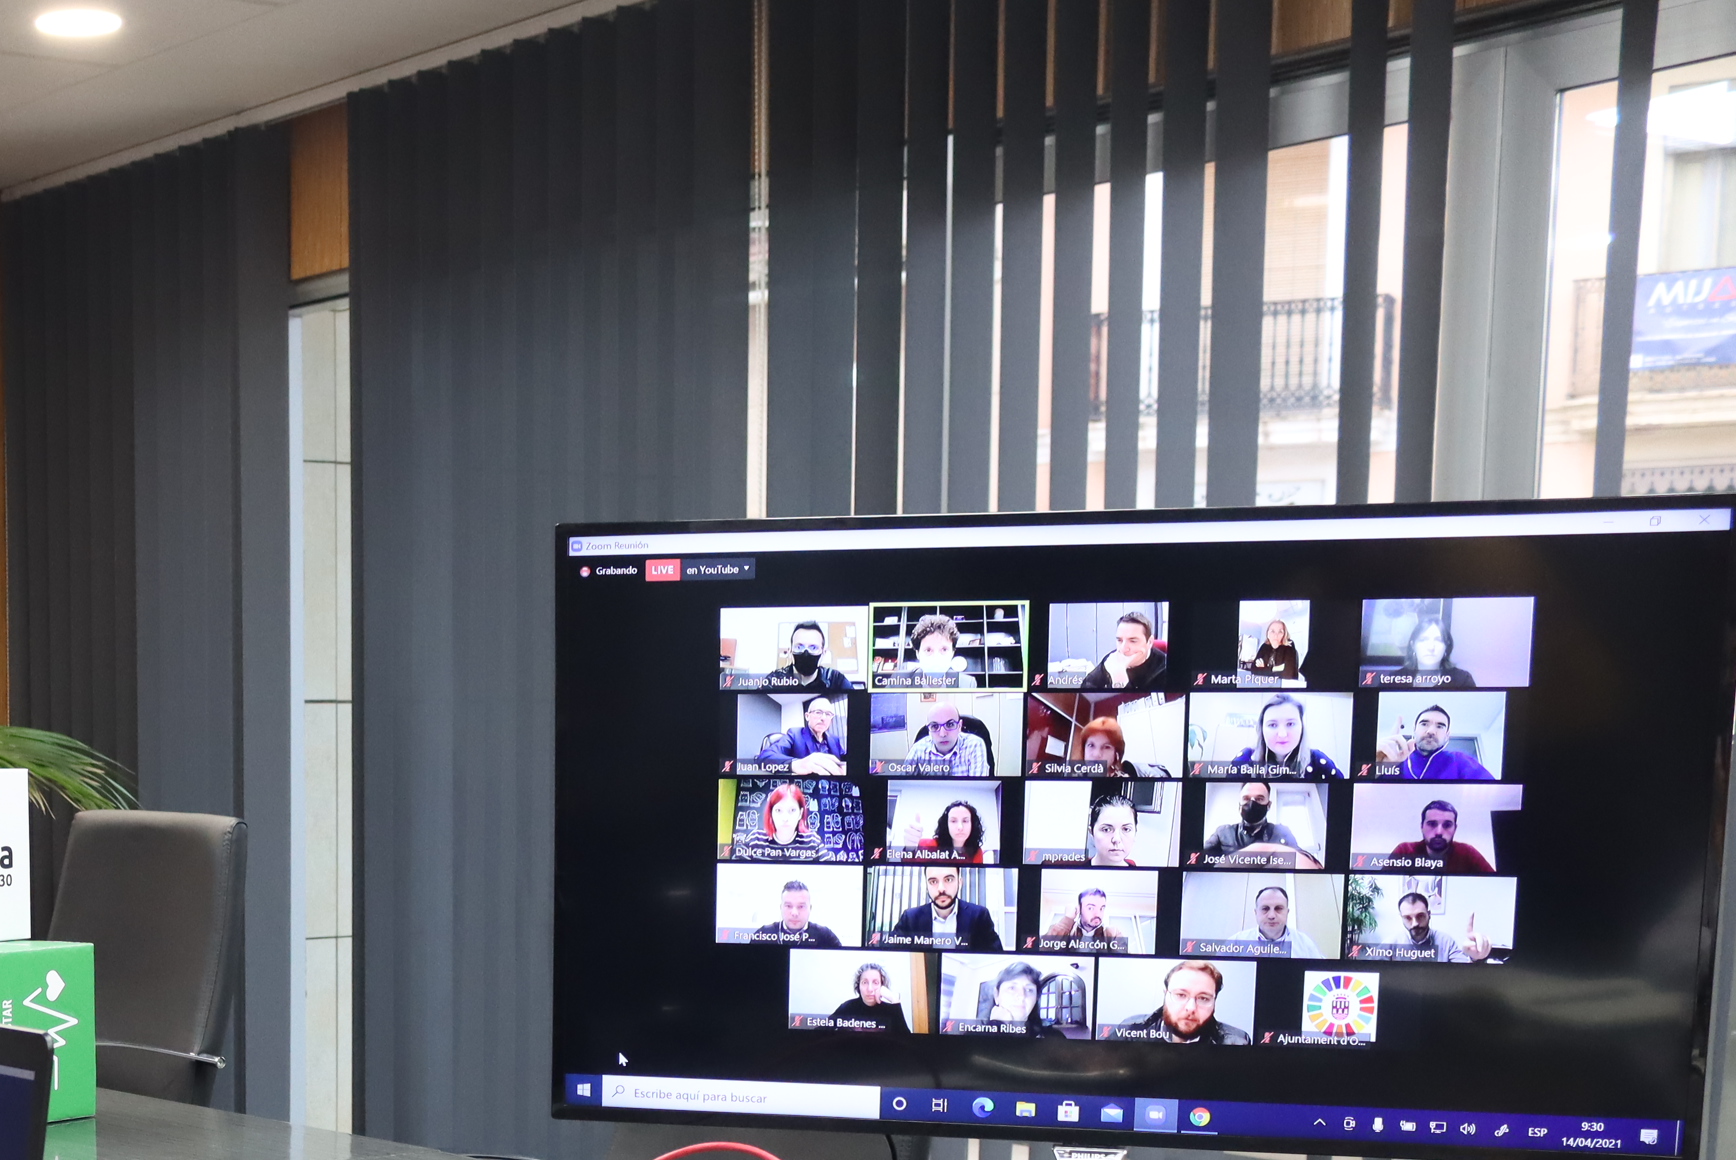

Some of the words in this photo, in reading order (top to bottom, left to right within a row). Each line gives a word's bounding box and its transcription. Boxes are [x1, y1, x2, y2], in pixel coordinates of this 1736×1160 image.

[586, 542, 611, 550] Zoom
[614, 541, 649, 549] Reunión
[596, 566, 638, 575] Grabando
[651, 565, 674, 574] LIVE
[686, 567, 698, 575] en
[699, 565, 739, 574] YouTube
[738, 677, 769, 688] Juanjo
[771, 676, 799, 686] Rubio
[915, 676, 956, 685] Ballester
[1048, 675, 1083, 685] Andrés
[1211, 675, 1242, 684] Marta
[1245, 674, 1279, 686] Piquer
[1380, 674, 1413, 684] teresa
[1415, 674, 1451, 686] arroyo
[737, 762, 759, 772] Juan
[761, 762, 789, 774] Lopez
[888, 763, 916, 772] Oscar
[918, 763, 950, 772] Valero
[1045, 763, 1071, 773] Silvia
[1207, 764, 1238, 774] María
[1240, 764, 1265, 774] Baila
[1376, 764, 1400, 776] Lluís
[735, 847, 762, 858] Dulce
[764, 848, 783, 858] Pan
[785, 848, 816, 859] Vargas
[886, 849, 912, 859] Elena
[915, 850, 949, 860] Albalat
[1042, 852, 1086, 863] mprades
[1203, 854, 1225, 864] José
[1228, 855, 1267, 864] Vicente
[1370, 857, 1412, 867] Asensio
[1415, 857, 1444, 870] Blaya
[734, 931, 778, 941] Francisco
[780, 931, 800, 941] José
[883, 935, 912, 945] Jaime
[914, 936, 952, 946] Manero
[1039, 939, 1066, 951] Jorge
[1069, 939, 1107, 950] Alarcón
[1200, 943, 1244, 953] Salvador
[1365, 948, 1393, 957] Ximo
[1395, 948, 1435, 959] Huguet
[807, 1018, 834, 1027] Estela
[837, 1018, 876, 1028] Badenes
[959, 1023, 998, 1033] Encarna
[1001, 1024, 1027, 1034] Ribes
[1115, 1028, 1146, 1038] Vicent
[1147, 1029, 1169, 1039] Bou
[1277, 1033, 1338, 1045] Ajuntament
[634, 1088, 672, 1100] Escribe
[675, 1089, 701, 1103] aquí
[703, 1093, 727, 1104] para
[731, 1092, 767, 1104] buscar
[1528, 1127, 1548, 1137] ESP
[1581, 1121, 1604, 1132] 9:30
[1562, 1137, 1622, 1149] 14/04/2021
